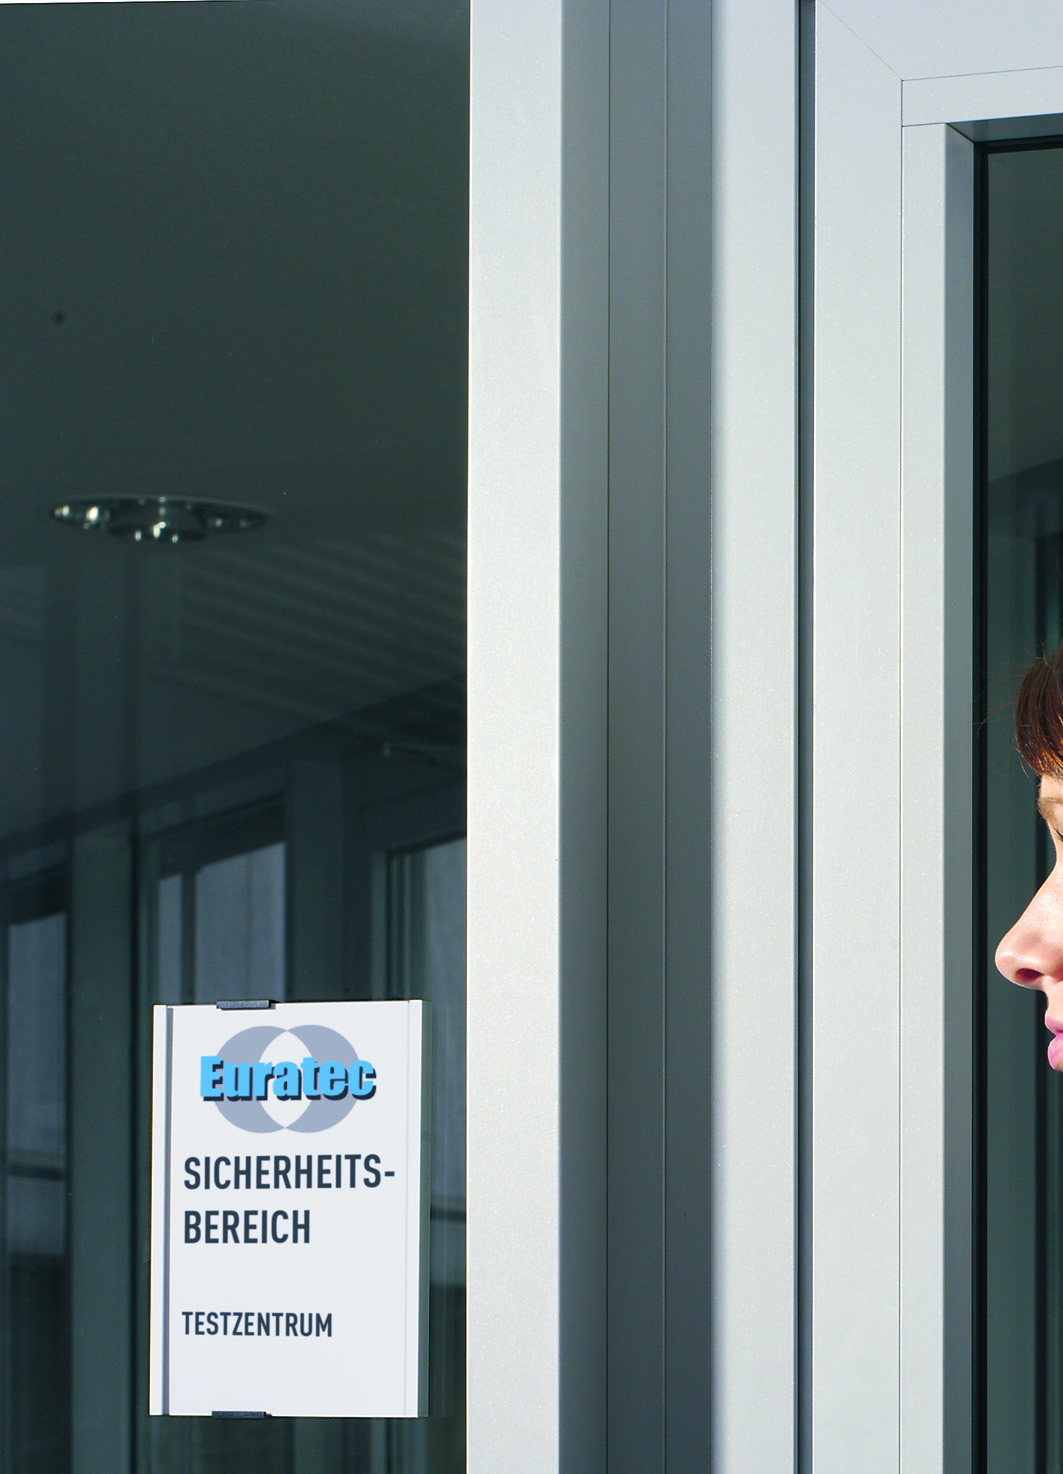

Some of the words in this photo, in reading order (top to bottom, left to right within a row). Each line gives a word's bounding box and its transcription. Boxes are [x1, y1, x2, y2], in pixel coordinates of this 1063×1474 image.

[200, 1056, 377, 1102] Euratec
[183, 1153, 396, 1190] SICHERHEITS-
[183, 1209, 311, 1244] BEREICH
[181, 1311, 333, 1338] TESTZENTRUM
